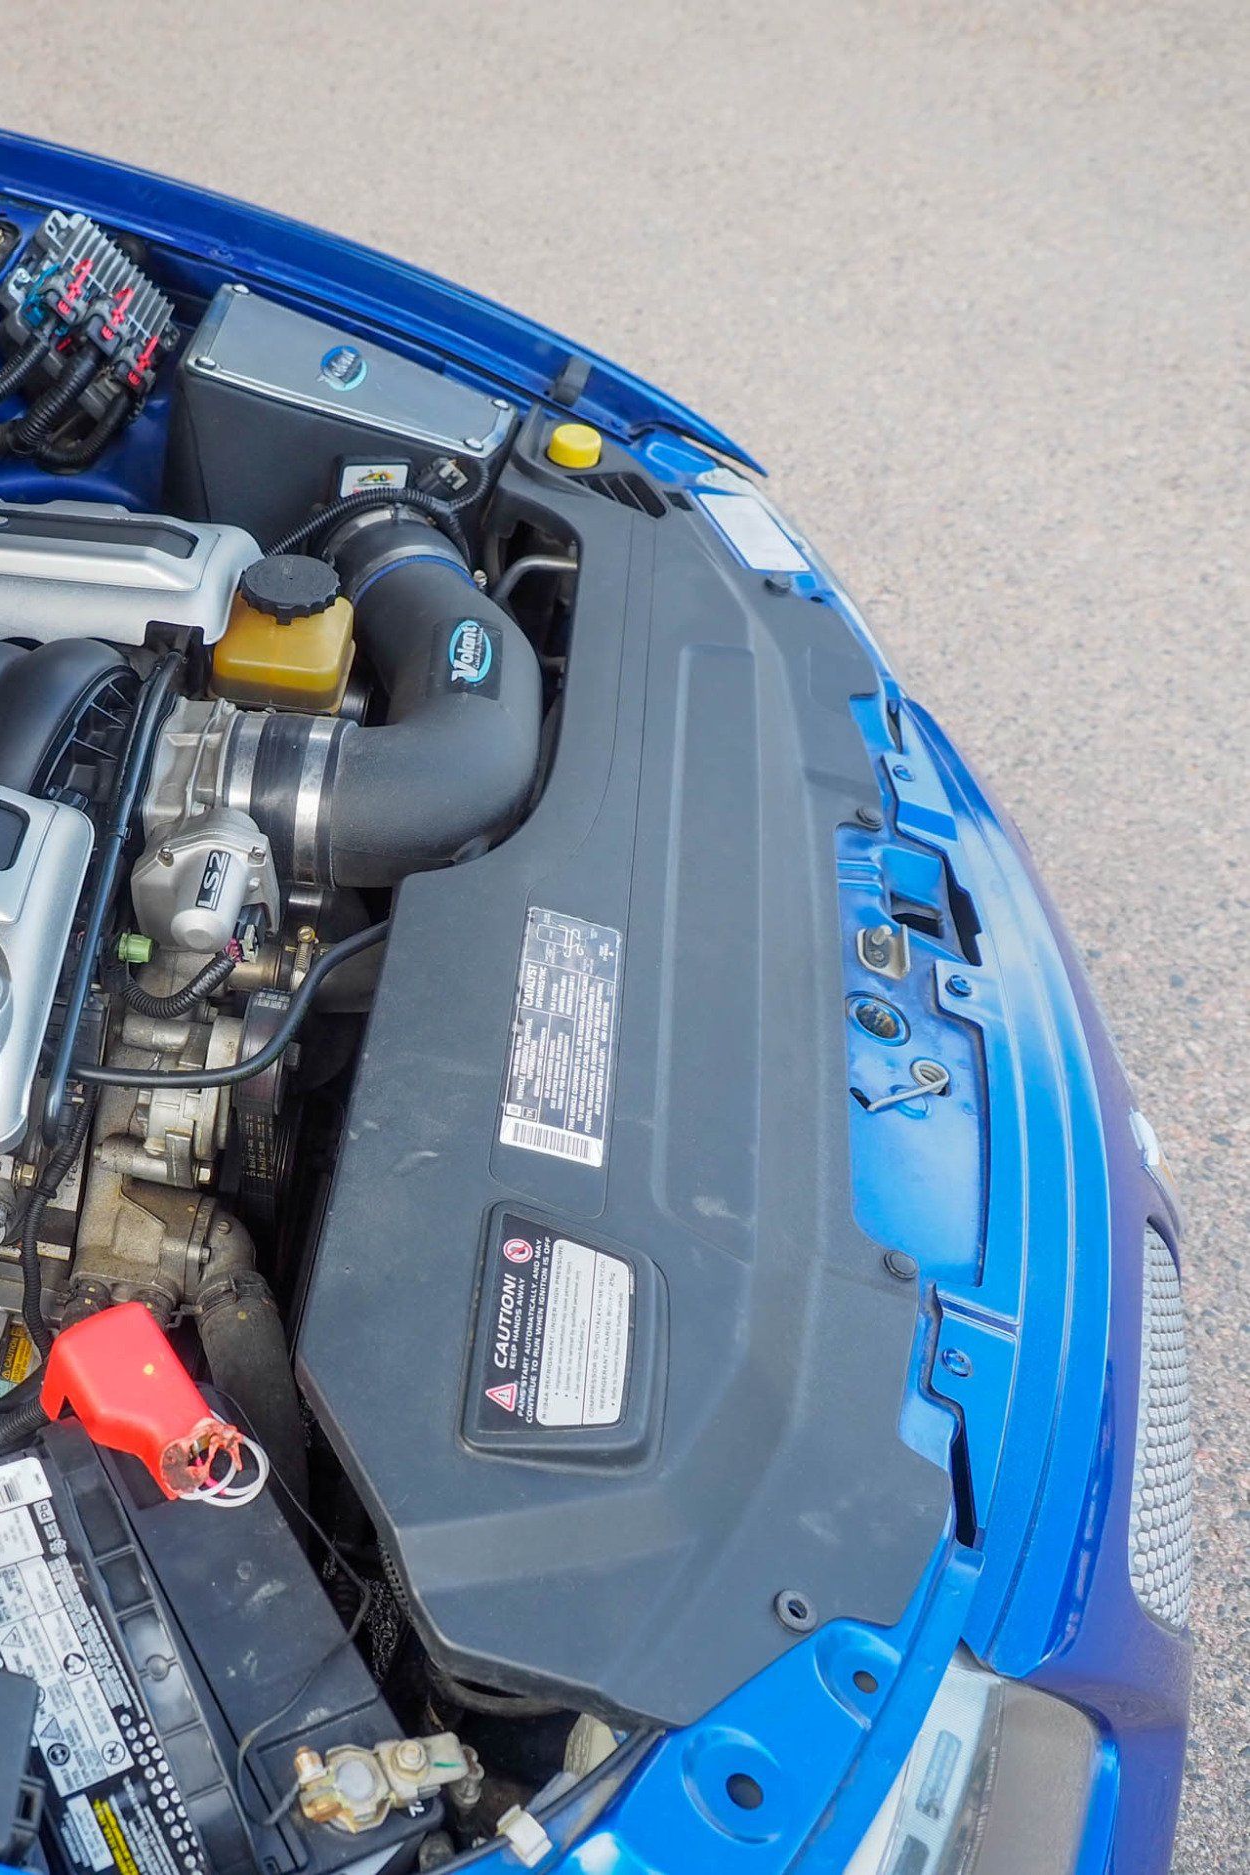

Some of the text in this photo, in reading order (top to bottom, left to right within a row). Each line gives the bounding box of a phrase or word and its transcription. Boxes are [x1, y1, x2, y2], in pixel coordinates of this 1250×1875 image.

[451, 624, 479, 682] Volant
[196, 852, 226, 909] LS2
[522, 963, 538, 1006] CATALYST
[523, 1017, 532, 1044] CONTROL
[532, 1261, 540, 1279] AND
[534, 1238, 543, 1259] MAY
[493, 1273, 517, 1369] CAUTION!
[508, 1276, 526, 1369] KEEP HANDS AWAY
[524, 1235, 552, 1423] CONTINUE TO RUN WHEN IGNITION IS OFF
[543, 1335, 555, 1389] REFRIGERANT
[549, 1306, 558, 1333] UNDER
[554, 1244, 564, 1285] PRESSURE
[3, 1337, 19, 1369] CAUTION
[519, 1356, 530, 1386] START
[587, 1362, 598, 1417] COMPRESSOR
[598, 1354, 608, 1409] REFRIGERANT
[38, 1503, 50, 1520] Pb
